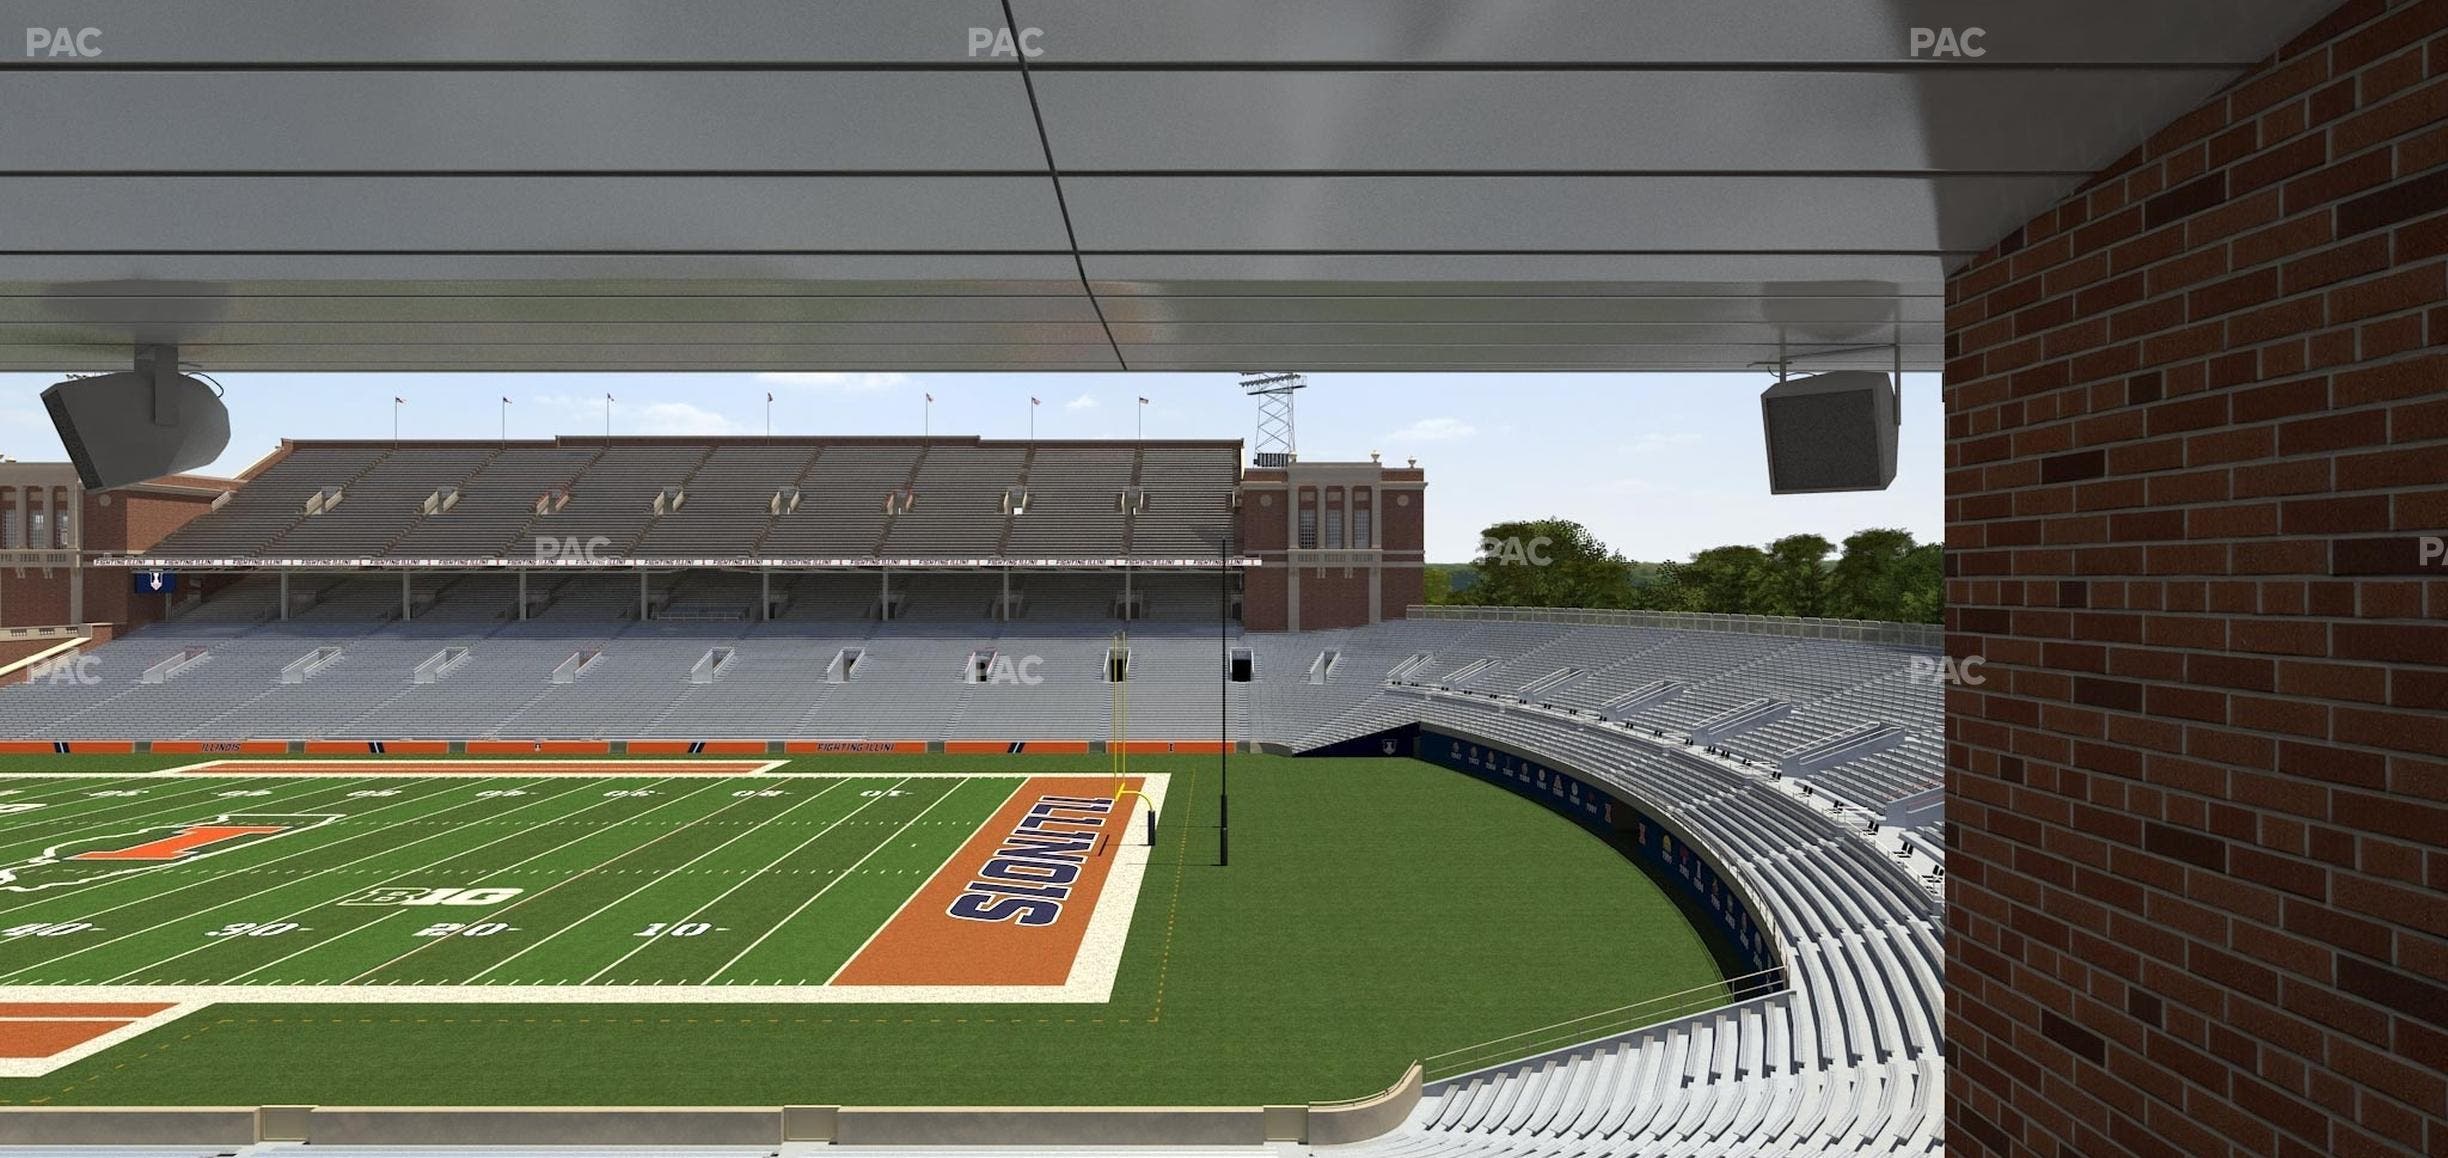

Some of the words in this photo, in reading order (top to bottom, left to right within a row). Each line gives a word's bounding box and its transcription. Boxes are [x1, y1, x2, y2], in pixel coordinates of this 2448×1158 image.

[201, 743, 241, 752] ILLINOIS
[817, 743, 863, 752] FIGHTING
[864, 743, 895, 752] ILLINI
[945, 795, 1116, 926] ILLINOIS
[0, 922, 93, 937] 40
[204, 922, 299, 937] 30
[411, 922, 511, 937] 20
[632, 922, 715, 938] 10
